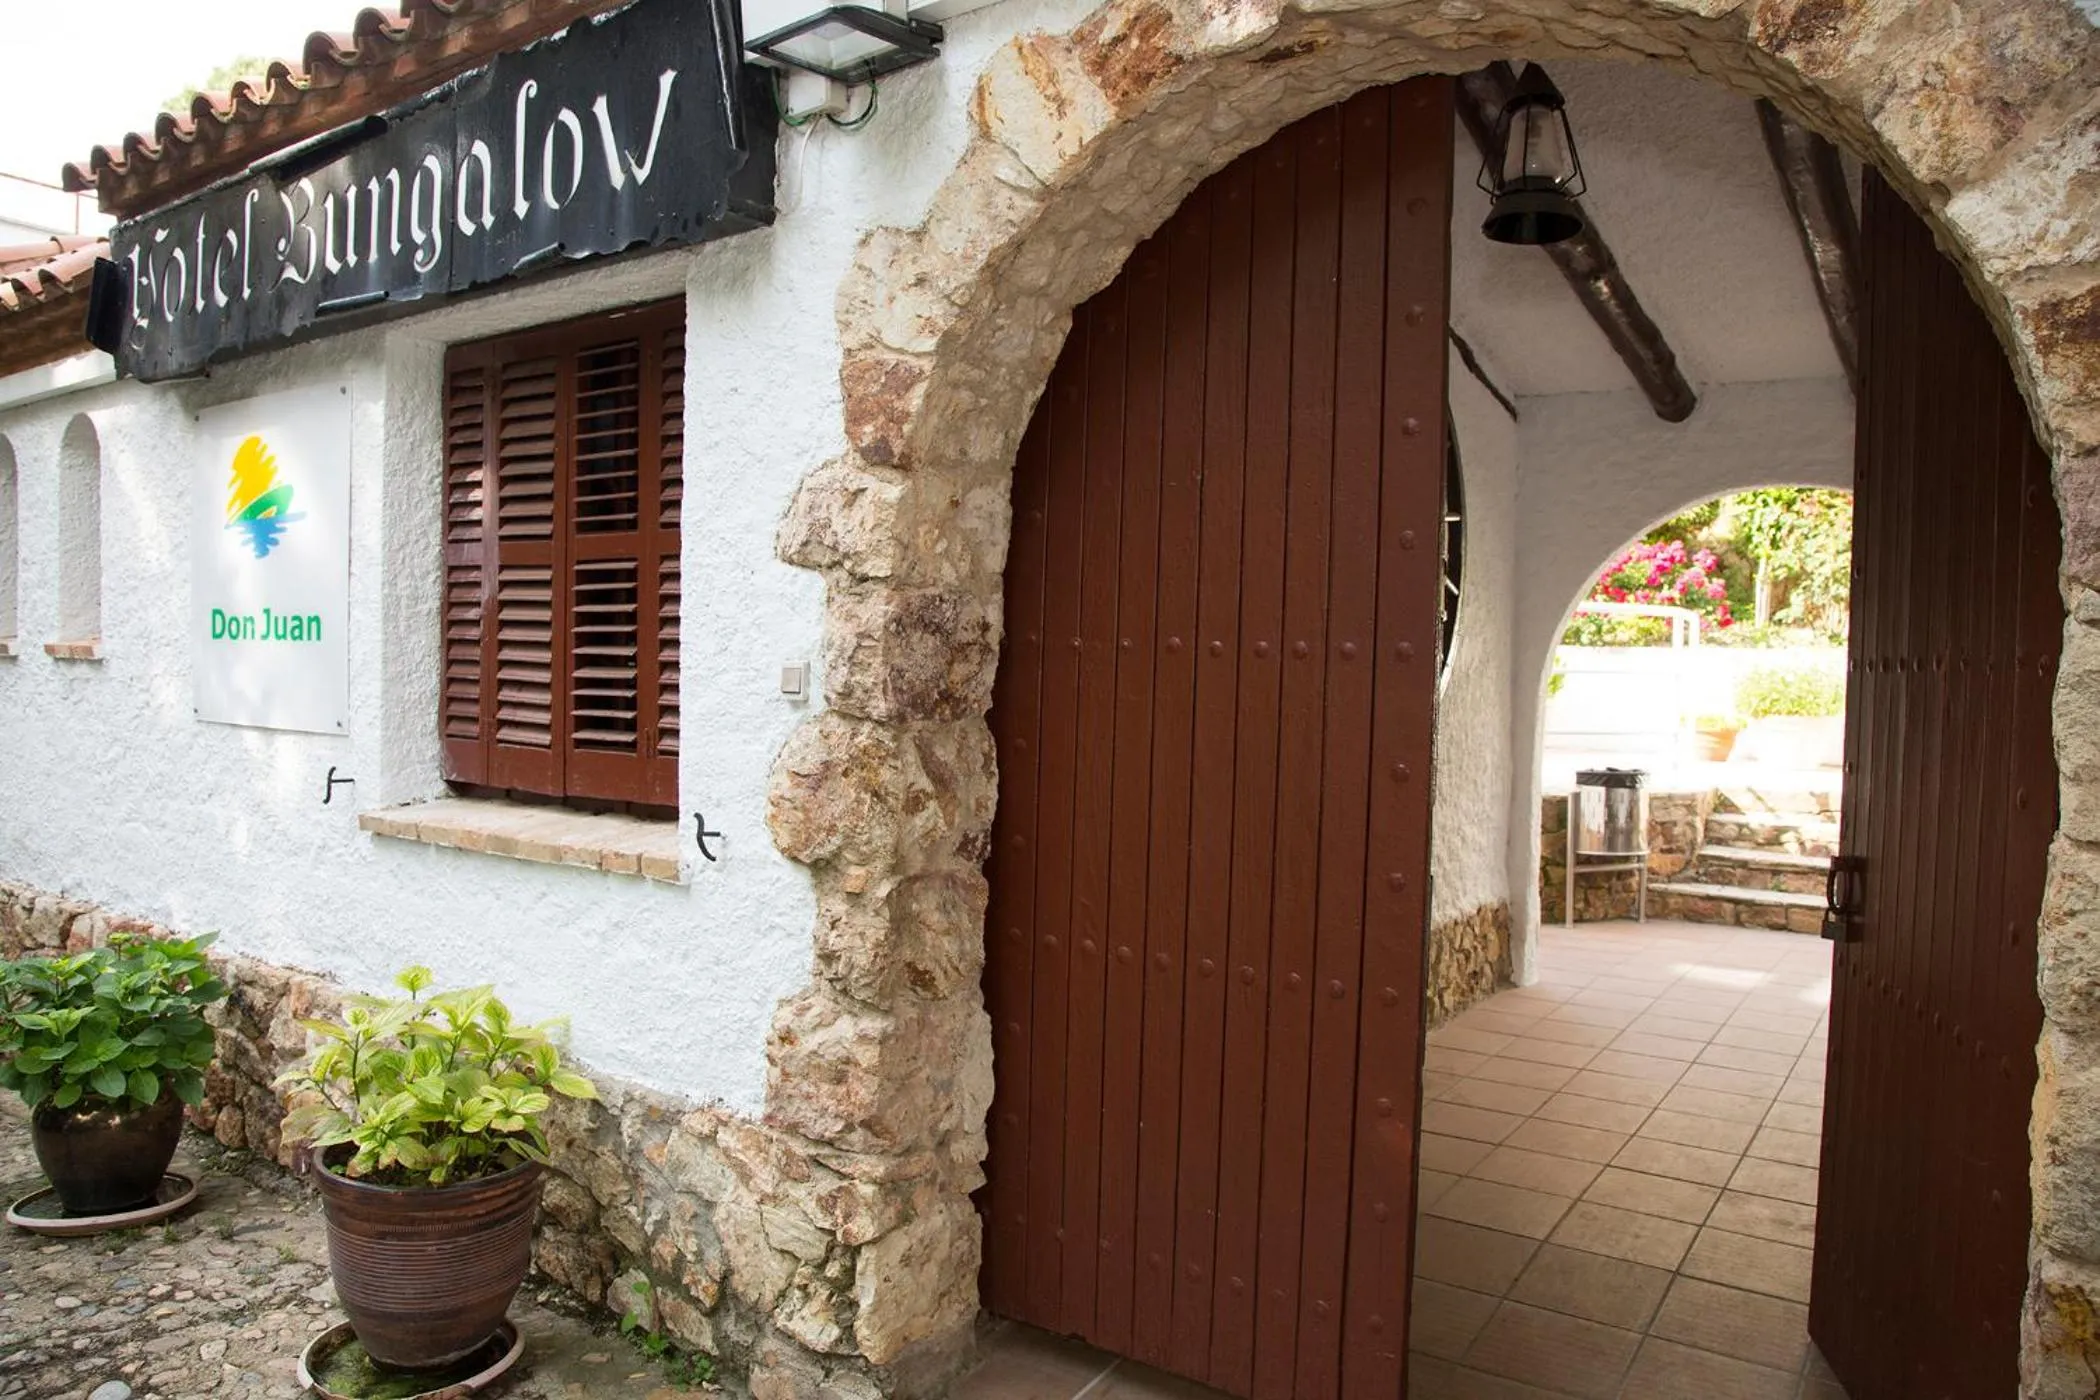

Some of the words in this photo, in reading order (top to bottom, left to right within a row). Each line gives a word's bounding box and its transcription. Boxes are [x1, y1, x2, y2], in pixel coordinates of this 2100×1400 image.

[128, 188, 259, 350] Hotel
[272, 68, 679, 285] Bungalow
[211, 608, 256, 640] Don
[260, 608, 321, 641] Juan
